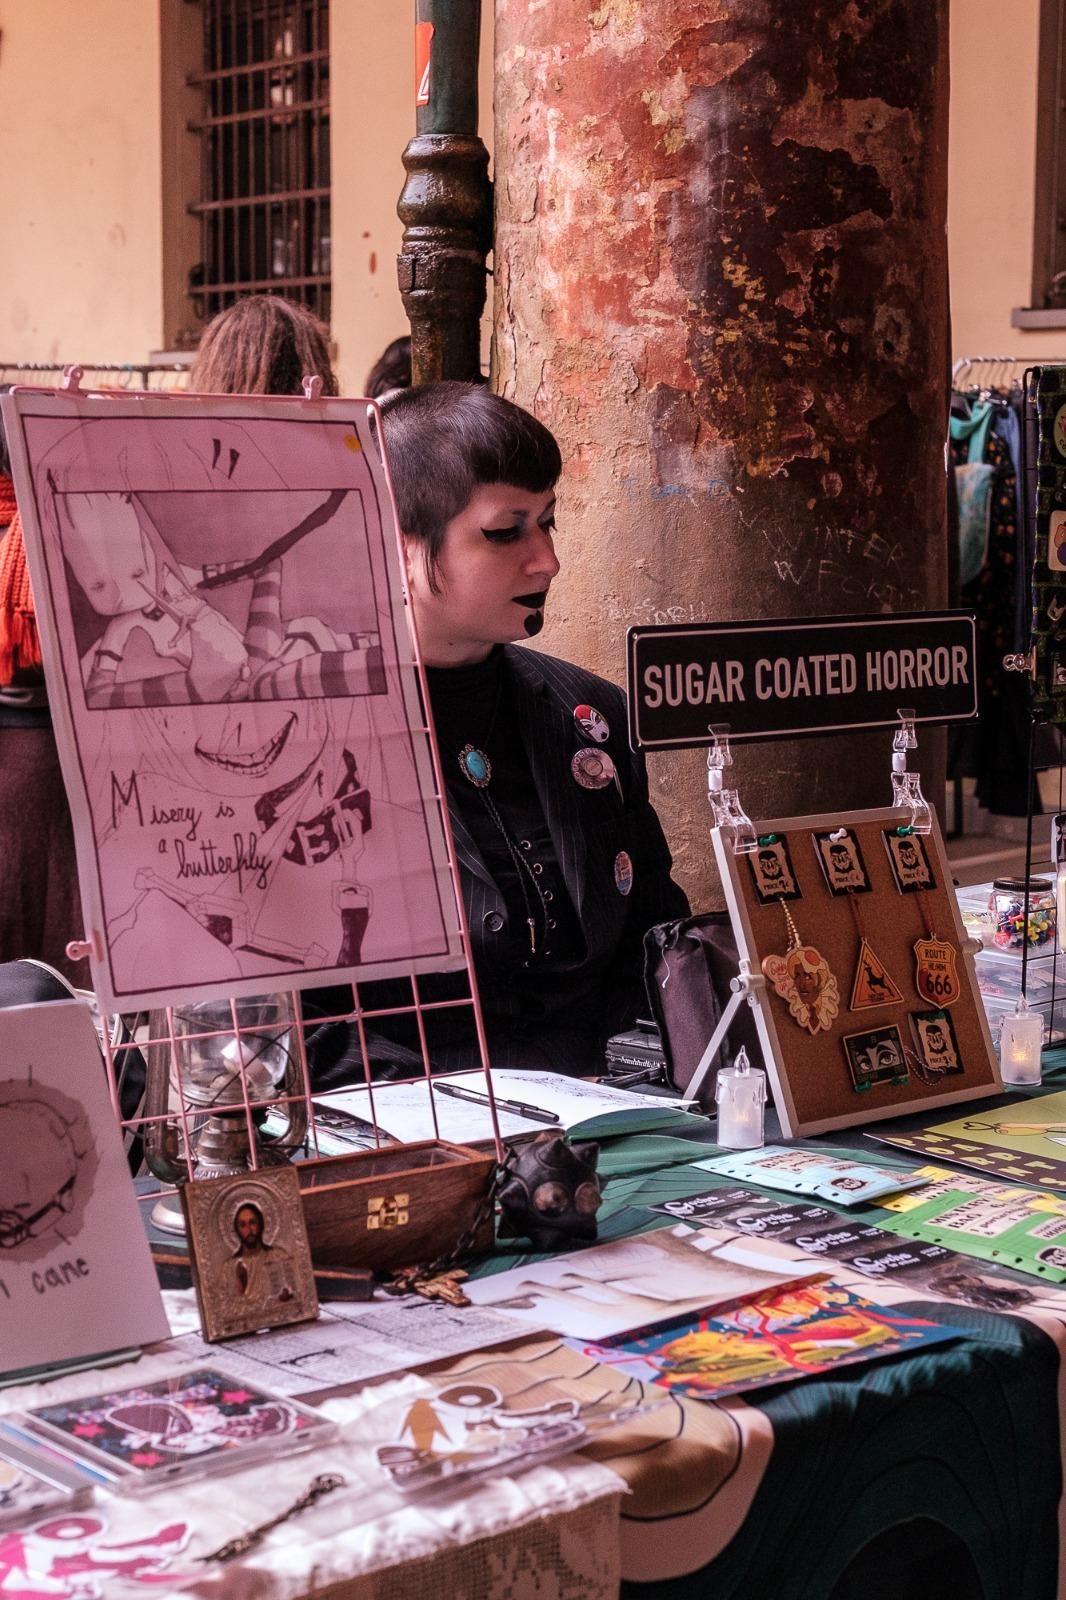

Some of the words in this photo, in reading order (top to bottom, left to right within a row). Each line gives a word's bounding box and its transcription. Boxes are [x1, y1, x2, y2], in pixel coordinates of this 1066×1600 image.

[643, 660, 746, 708] SUGAR
[755, 653, 857, 700] COATED
[866, 645, 969, 692] HORROR
[111, 769, 202, 842] Misery
[215, 801, 235, 818] is
[158, 838, 168, 854] a
[174, 832, 272, 894] butterfly
[924, 948, 947, 960] ROUTE
[926, 973, 953, 995] 666
